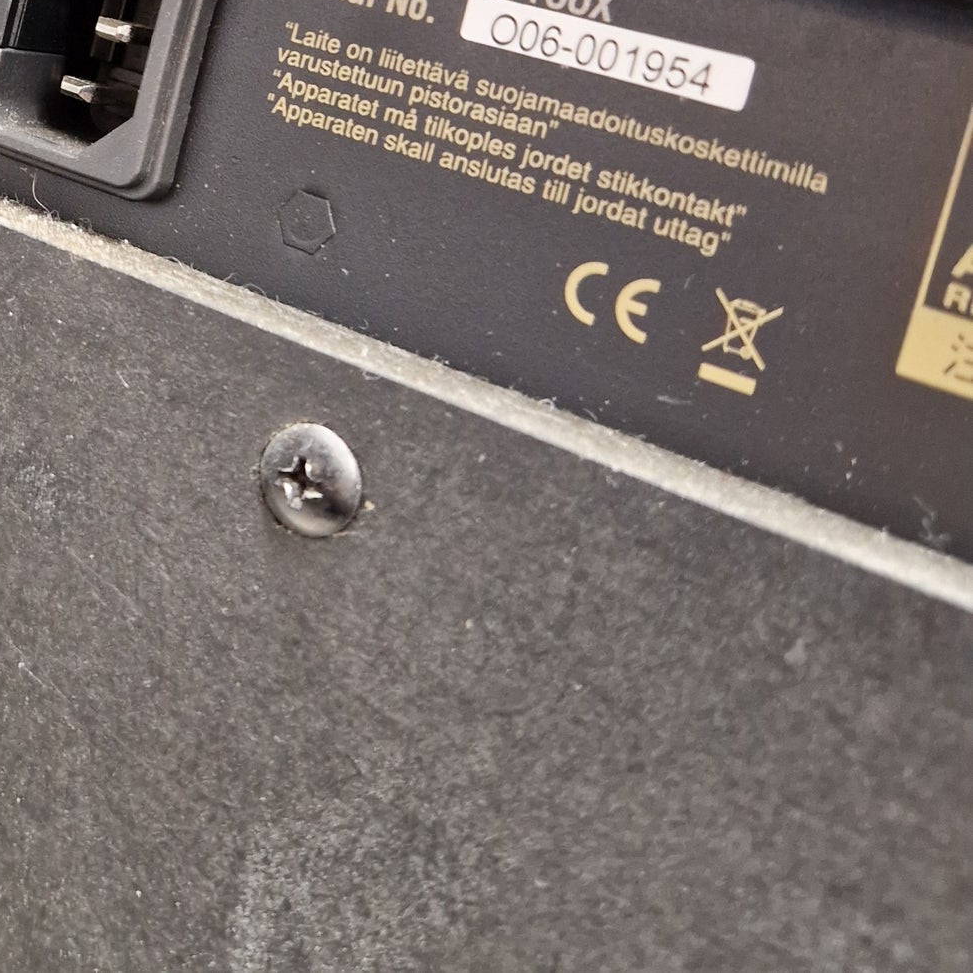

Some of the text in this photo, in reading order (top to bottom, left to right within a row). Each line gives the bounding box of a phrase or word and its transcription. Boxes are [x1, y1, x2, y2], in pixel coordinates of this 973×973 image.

[278, 47, 404, 97] varustettuun
[346, 42, 373, 63] on
[378, 47, 469, 91] liitettävä
[475, 76, 828, 195] suojamaadoituskoskettimilla
[383, 106, 418, 131] må
[424, 115, 516, 160] tilkoples
[519, 142, 592, 183] jordet
[383, 133, 435, 163] skall
[438, 150, 535, 195] anslutas
[542, 178, 571, 205] till
[571, 186, 648, 230] jordat
[564, 260, 661, 345] CE
